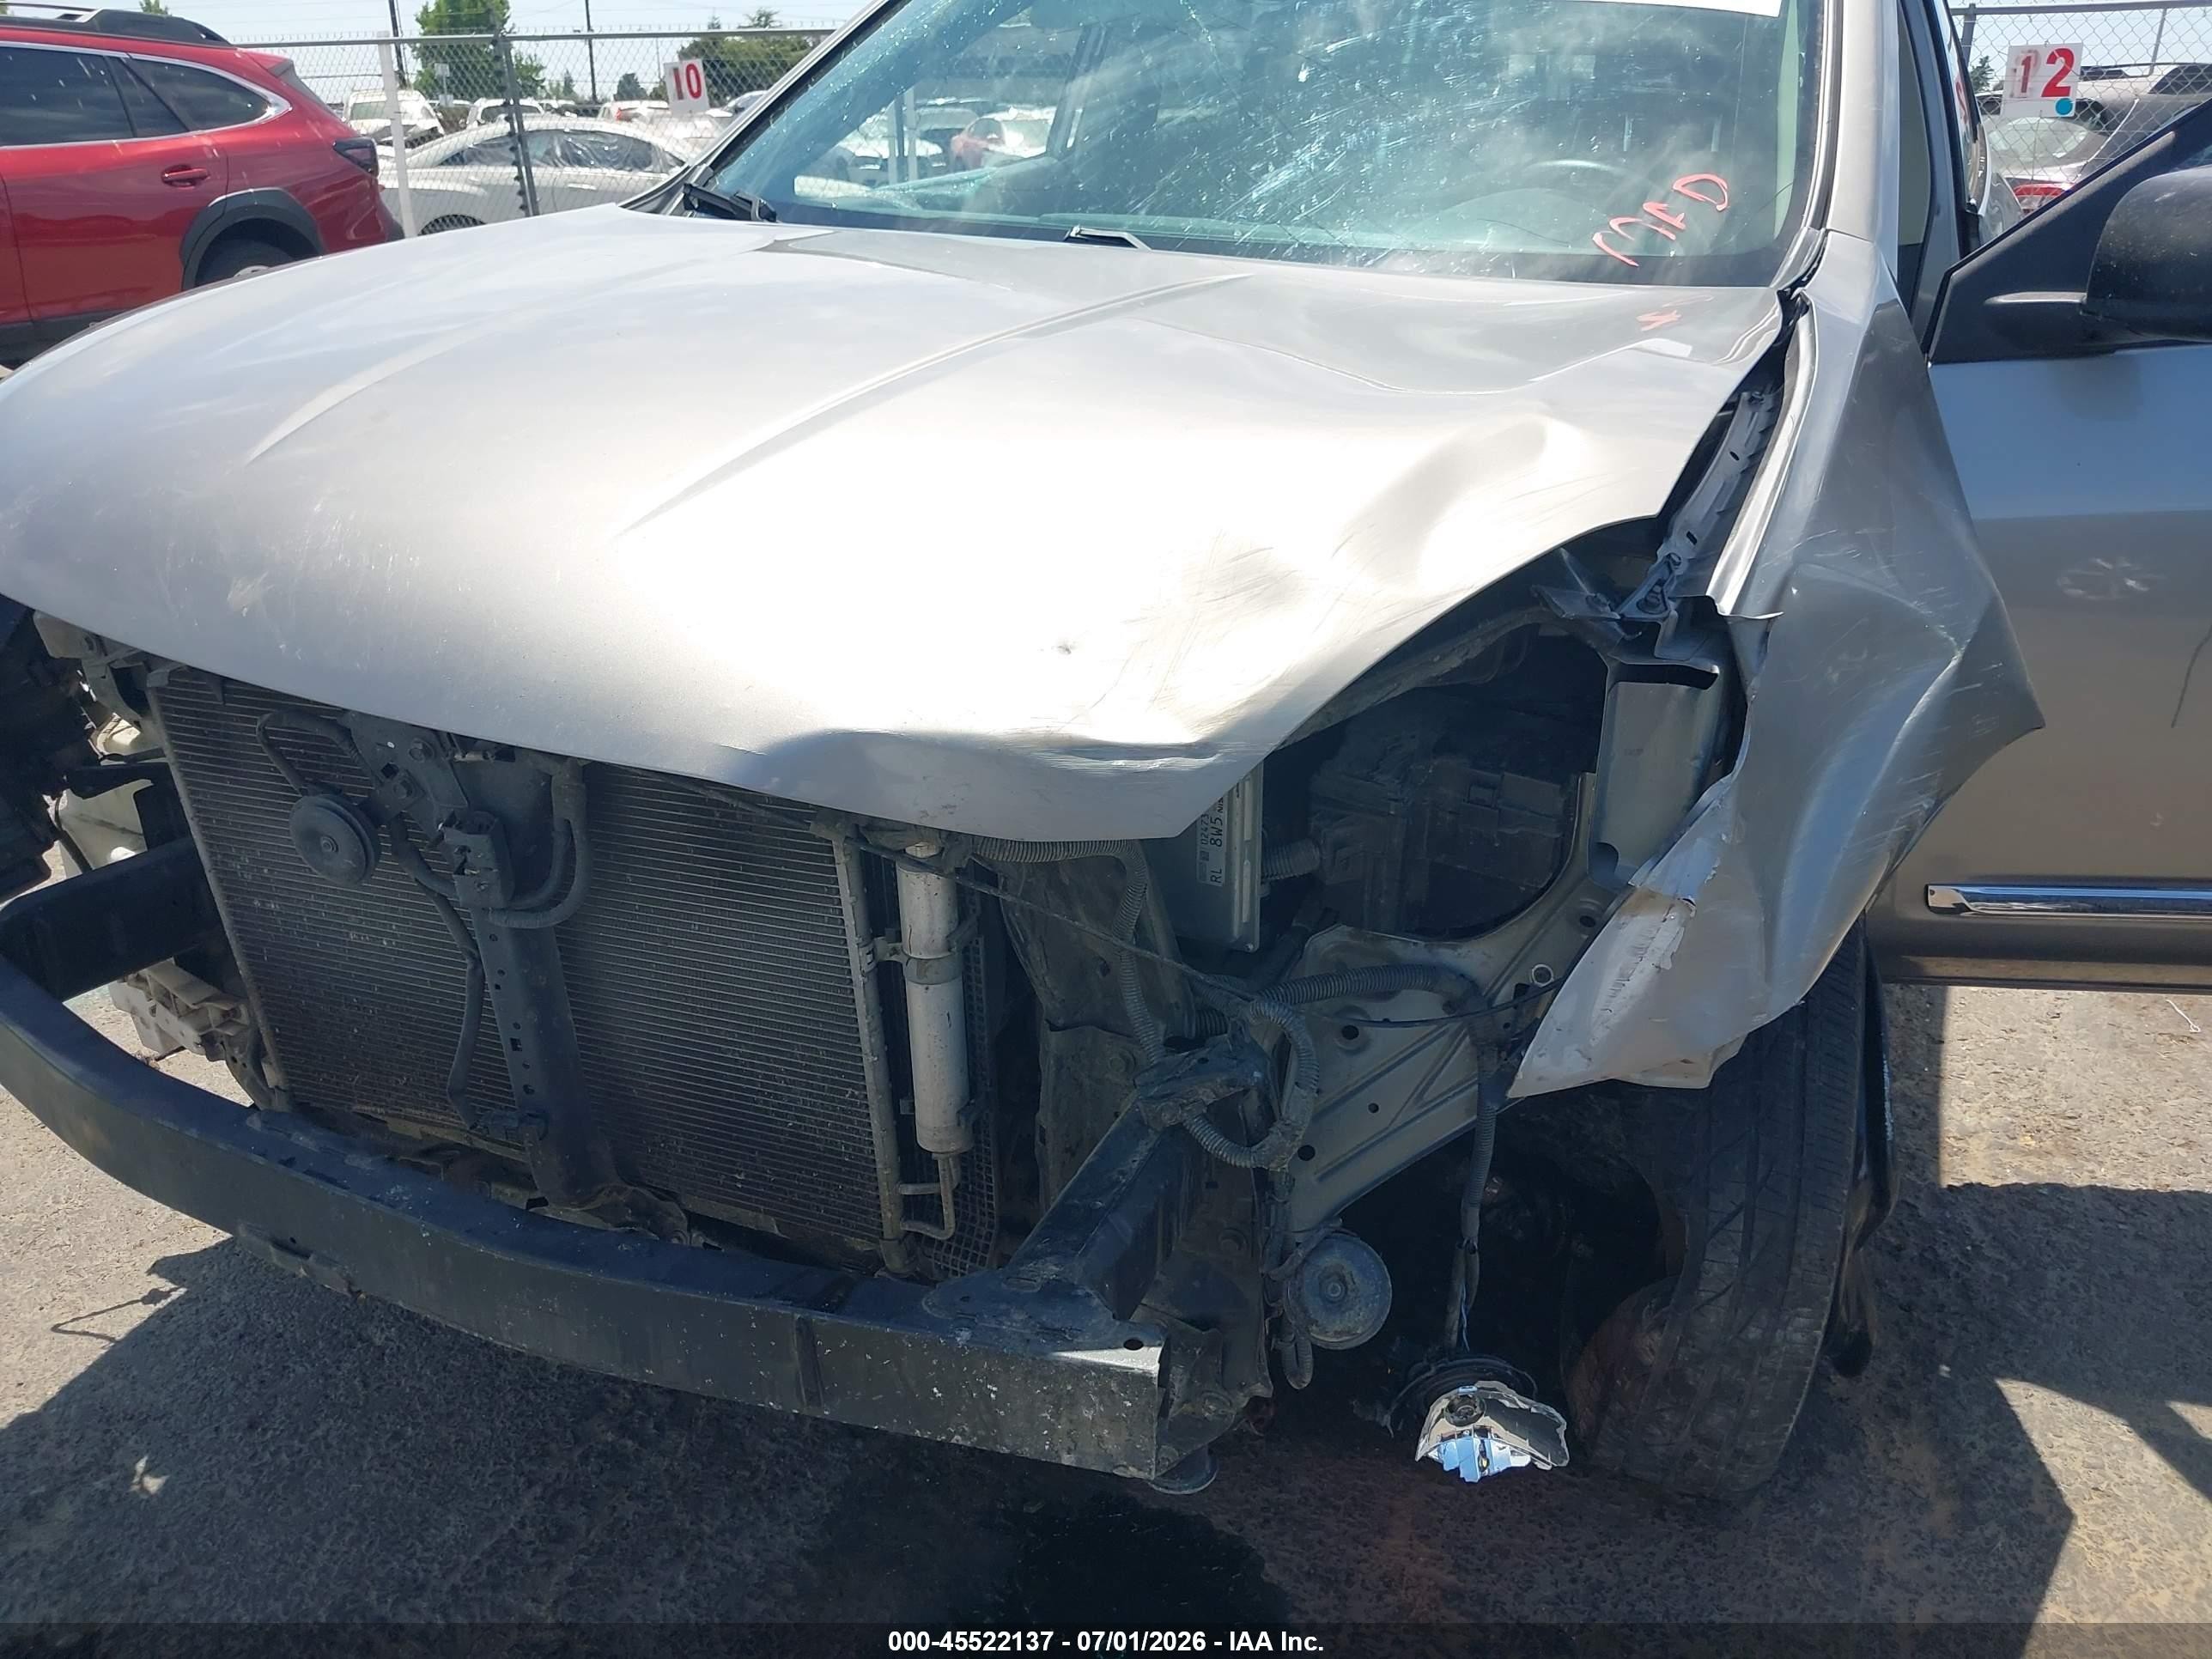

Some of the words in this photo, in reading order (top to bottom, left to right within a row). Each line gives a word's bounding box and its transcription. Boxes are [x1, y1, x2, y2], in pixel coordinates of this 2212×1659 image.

[672, 63, 702, 100] 10
[2020, 47, 2075, 98] 12
[1209, 815, 1224, 847] 8W5
[1210, 868, 1223, 884] RL
